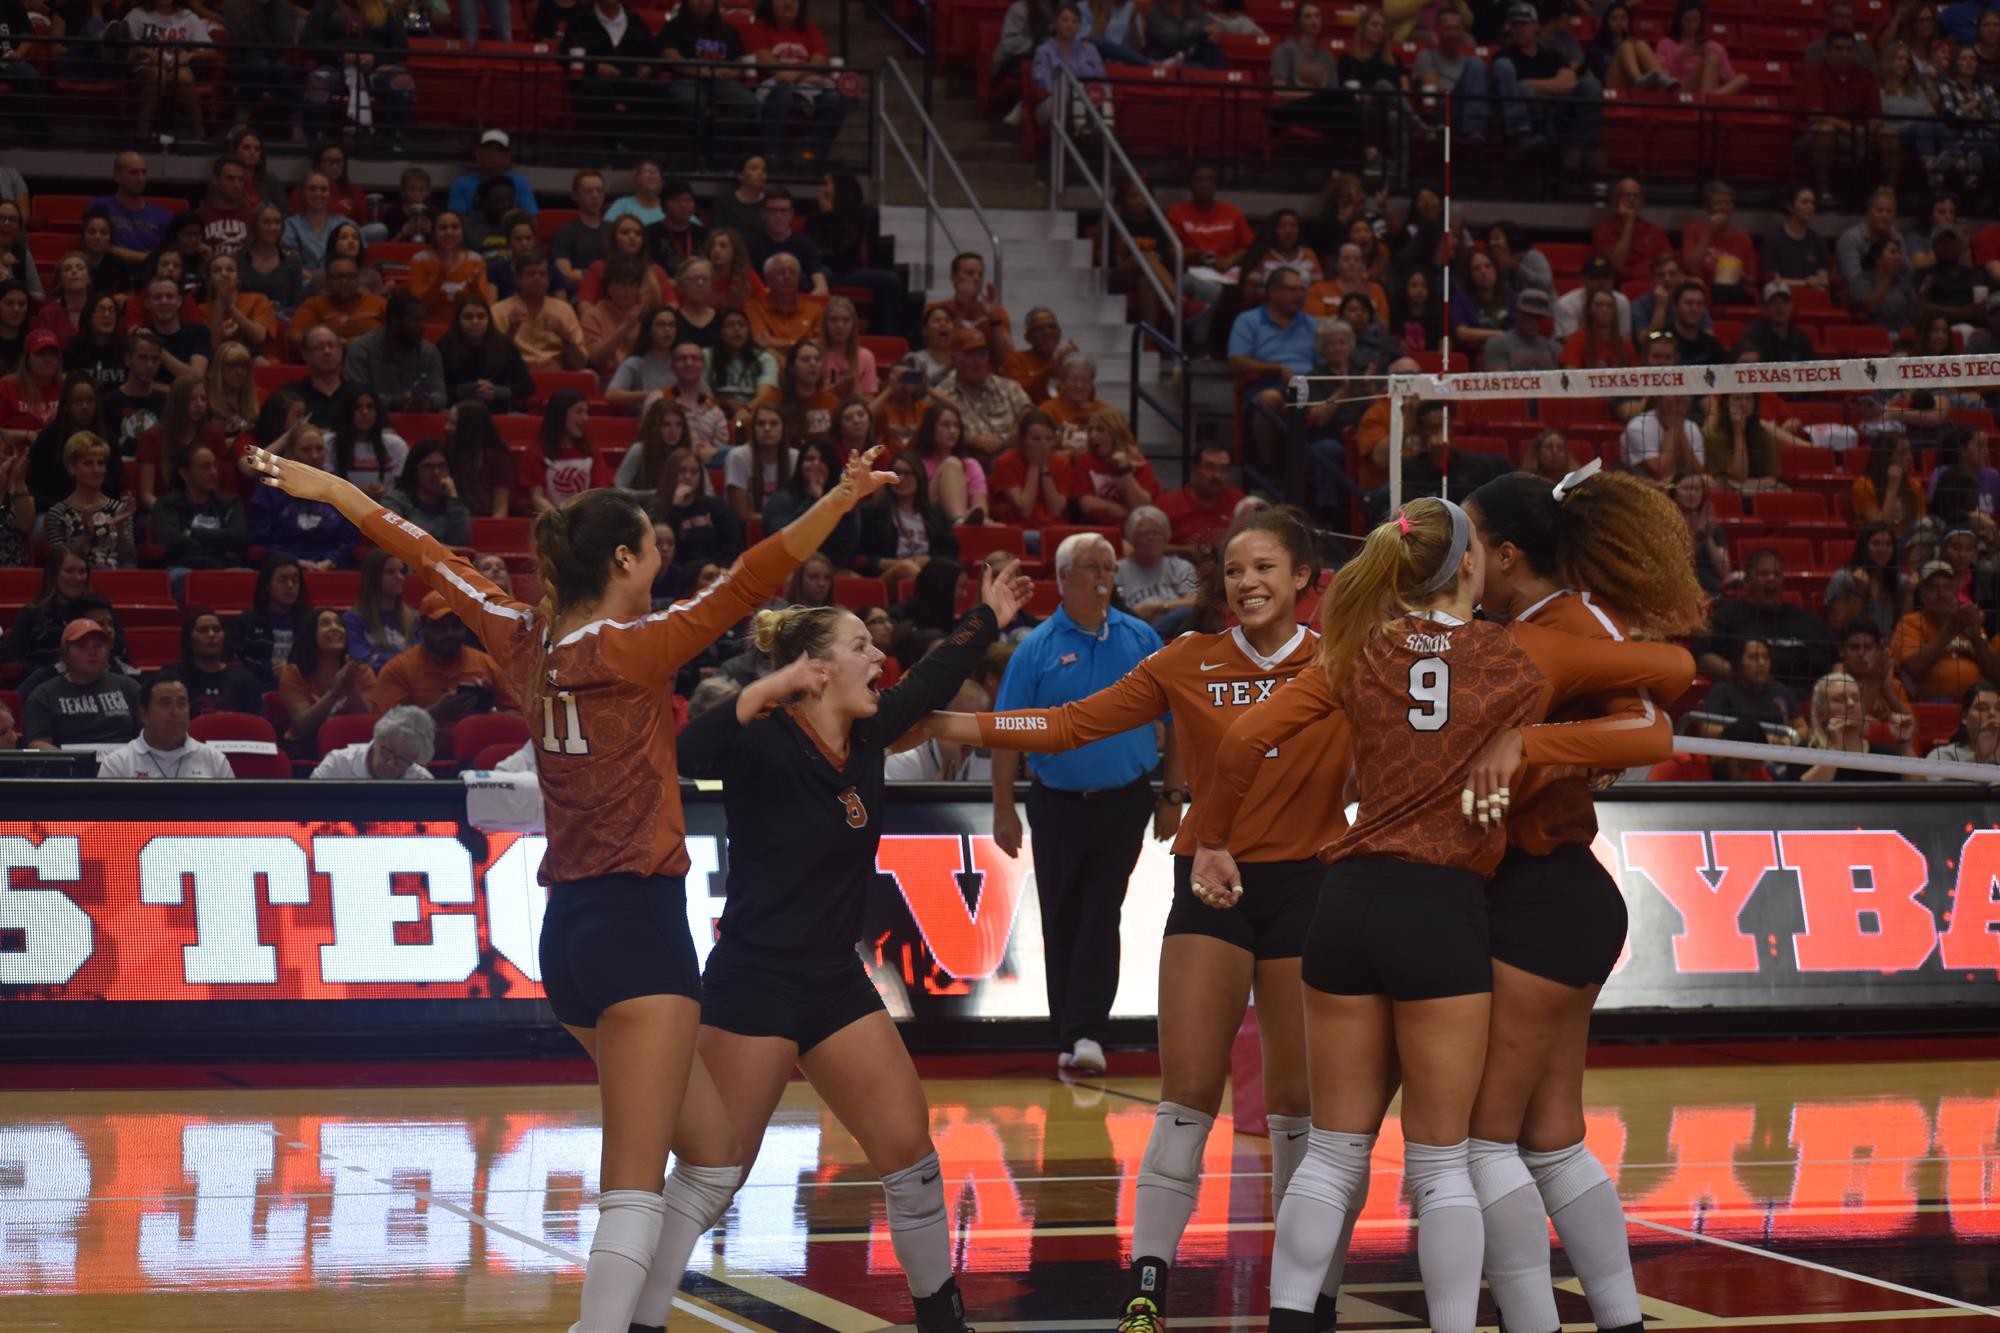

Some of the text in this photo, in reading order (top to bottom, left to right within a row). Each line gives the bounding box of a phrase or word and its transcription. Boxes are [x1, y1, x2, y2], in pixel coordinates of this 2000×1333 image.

[1735, 366, 1841, 384] TEXAS TECH
[1899, 362, 1962, 379] TEXAS
[1452, 376, 1541, 392] TEXAS TECH
[1588, 372, 1684, 388] TEXAS TECH
[1407, 656, 1450, 732] 9
[542, 691, 590, 755] 11
[994, 716, 1048, 730] HORNS
